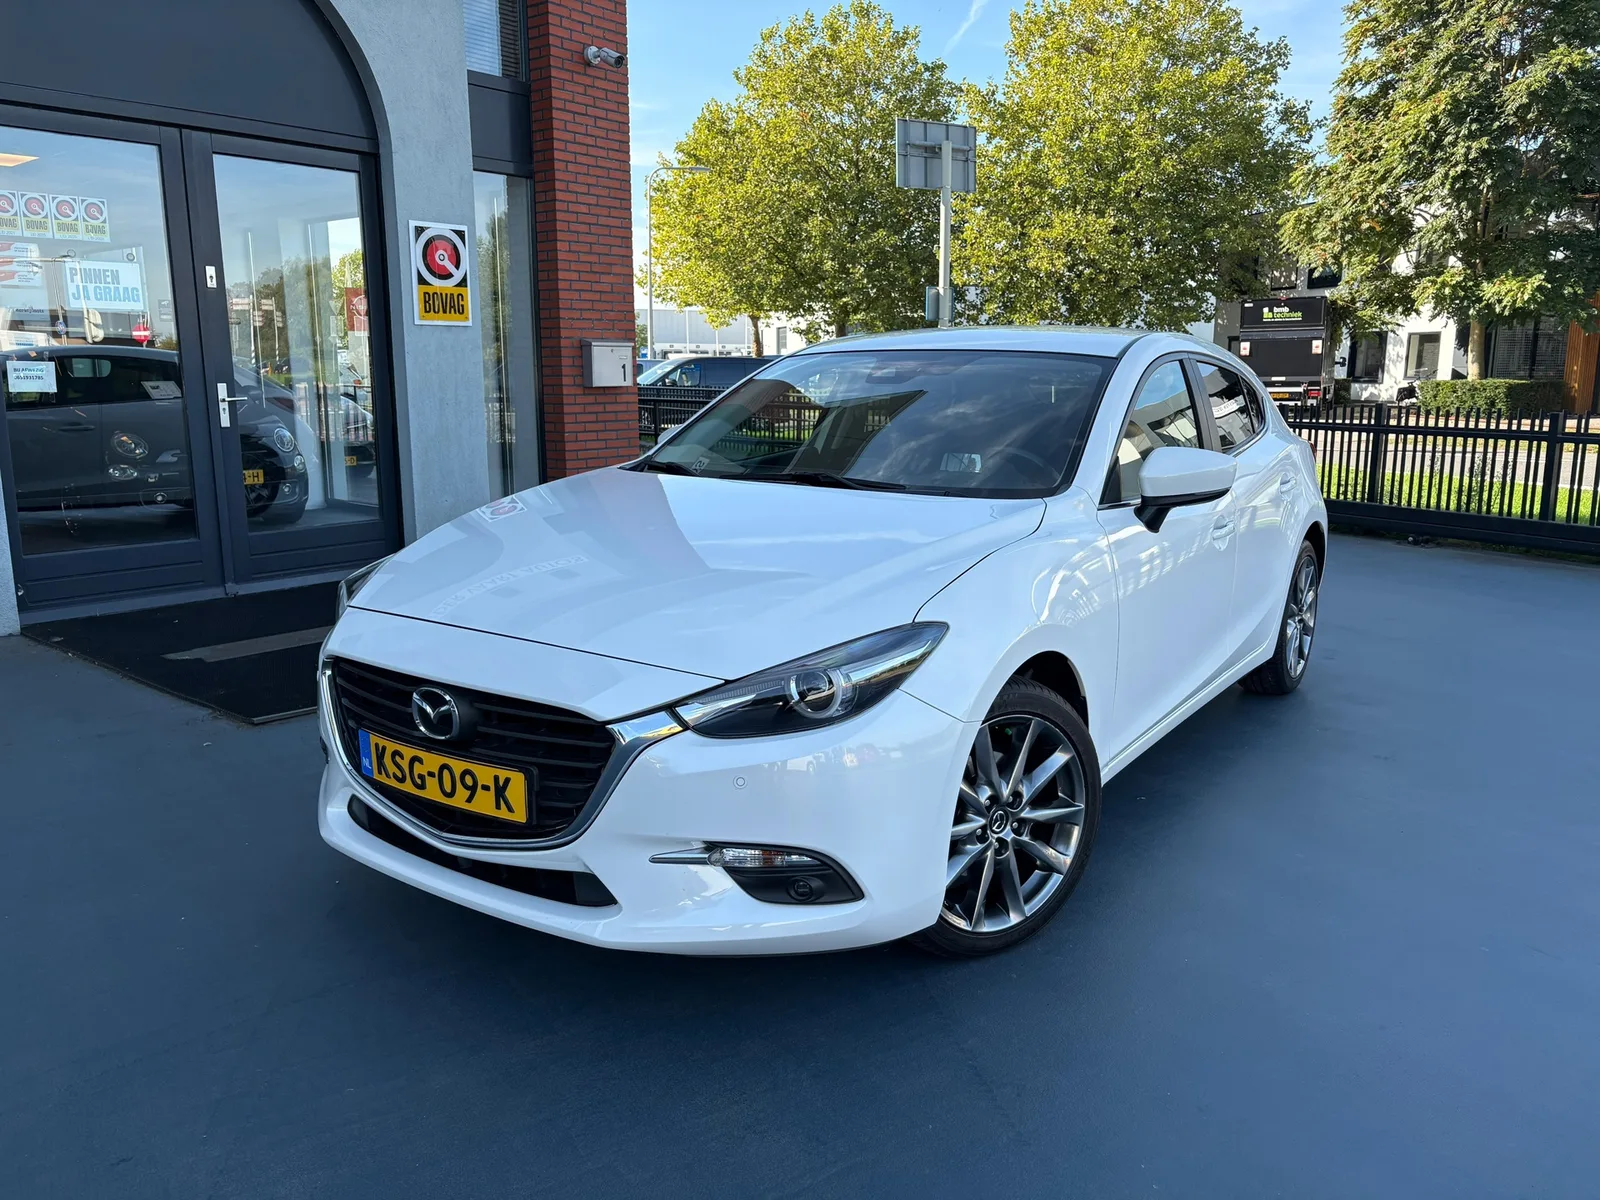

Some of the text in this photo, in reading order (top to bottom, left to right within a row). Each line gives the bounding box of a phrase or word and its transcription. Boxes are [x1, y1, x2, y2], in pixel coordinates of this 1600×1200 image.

[26, 219, 48, 230] BOVAG
[57, 222, 79, 233] BOVAG
[85, 224, 106, 235] BOVAG
[69, 267, 120, 285] PINNEN
[72, 285, 140, 303] JA GRAAG
[423, 291, 465, 315] BOVAG
[621, 363, 626, 382] 1
[362, 756, 372, 769] NL
[374, 742, 515, 814] KSG-09-K
